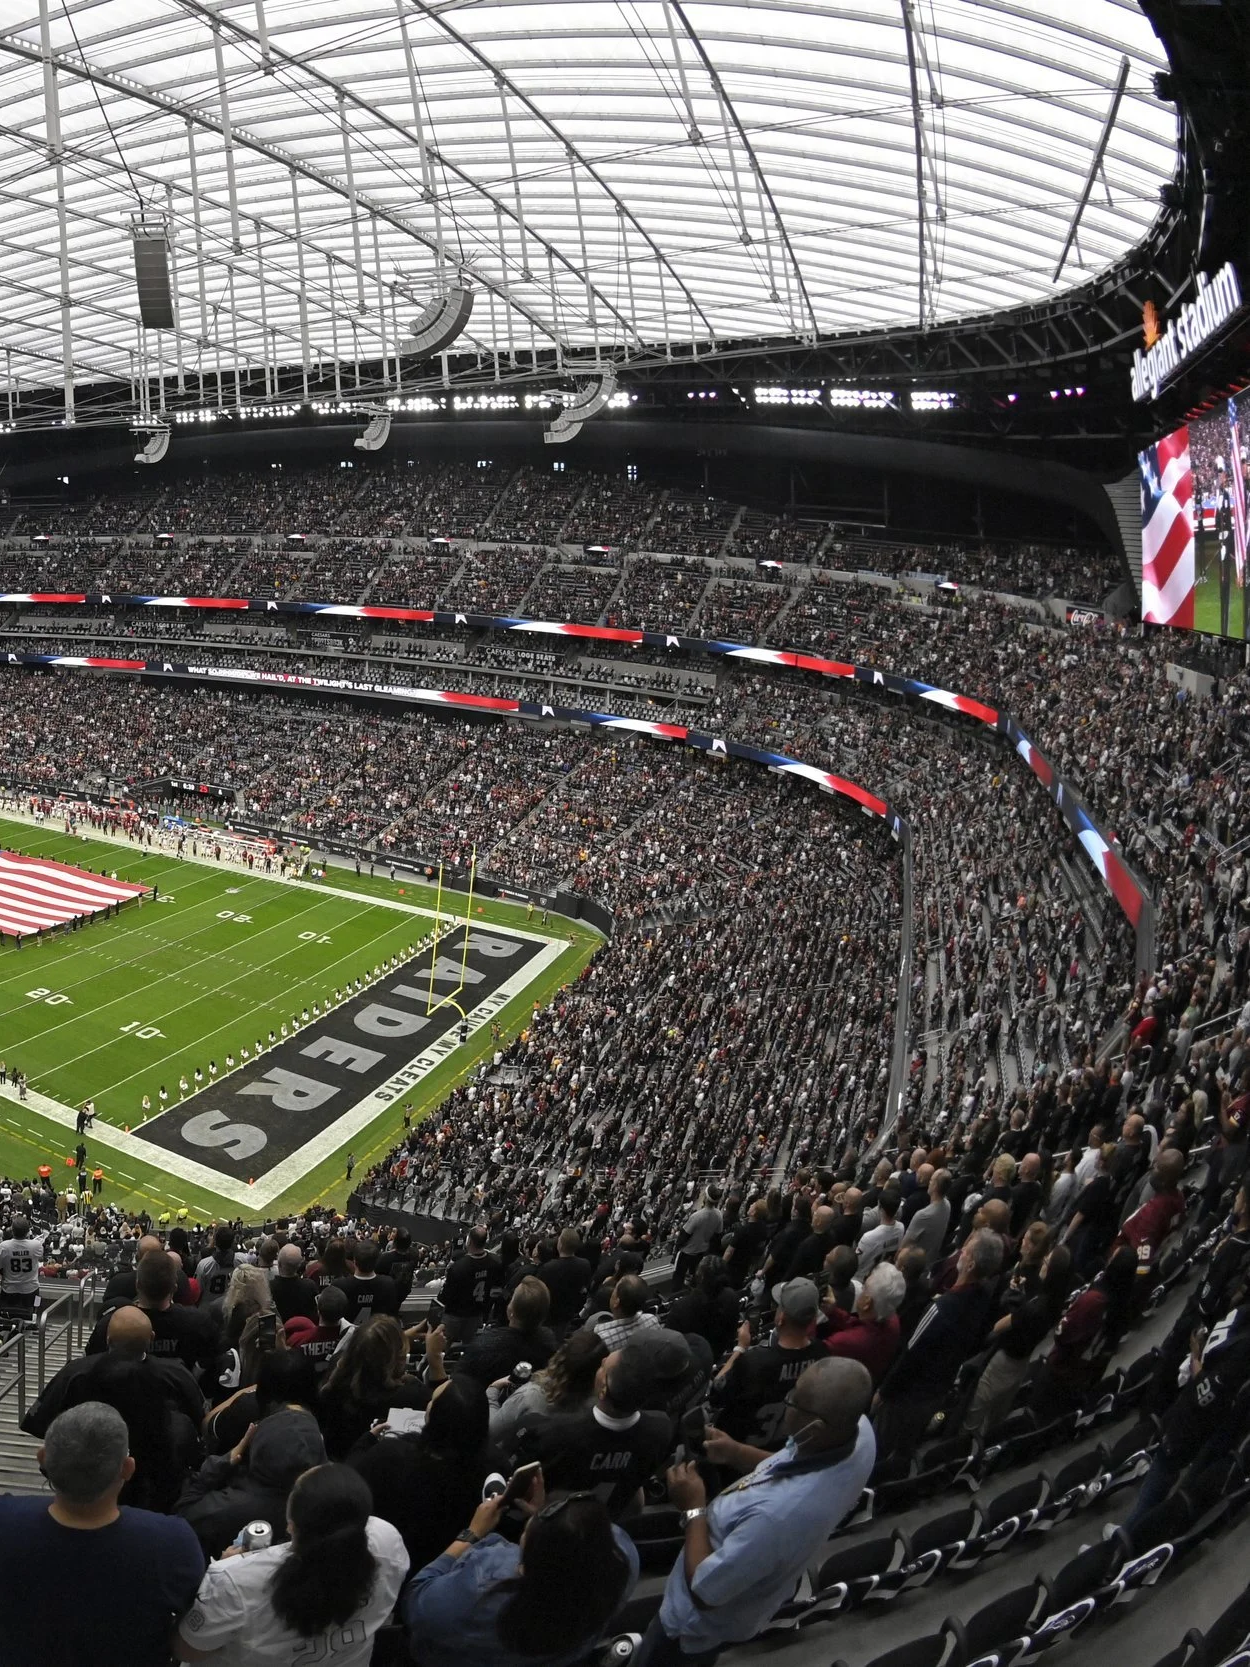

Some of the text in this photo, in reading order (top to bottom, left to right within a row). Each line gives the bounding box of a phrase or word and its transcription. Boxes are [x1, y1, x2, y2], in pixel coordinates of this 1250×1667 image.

[1130, 261, 1242, 402] allegiant stadium
[486, 648, 515, 657] CAESARS
[518, 651, 534, 659] LOGE
[188, 666, 206, 674] WHAT
[298, 676, 311, 684] THE
[354, 682, 373, 691] LAST
[216, 910, 252, 923] 20
[298, 931, 331, 944] 10
[24, 987, 69, 1005] 20
[119, 1021, 162, 1039] 10
[180, 933, 524, 1161] RAIDERS
[375, 992, 511, 1101] MY CAUE MY CLEATS
[10, 1258, 33, 1273] 83
[357, 1294, 375, 1304] CARR
[473, 1281, 486, 1302] 4
[1196, 1377, 1216, 1407] 28
[589, 1452, 633, 1472] CARR
